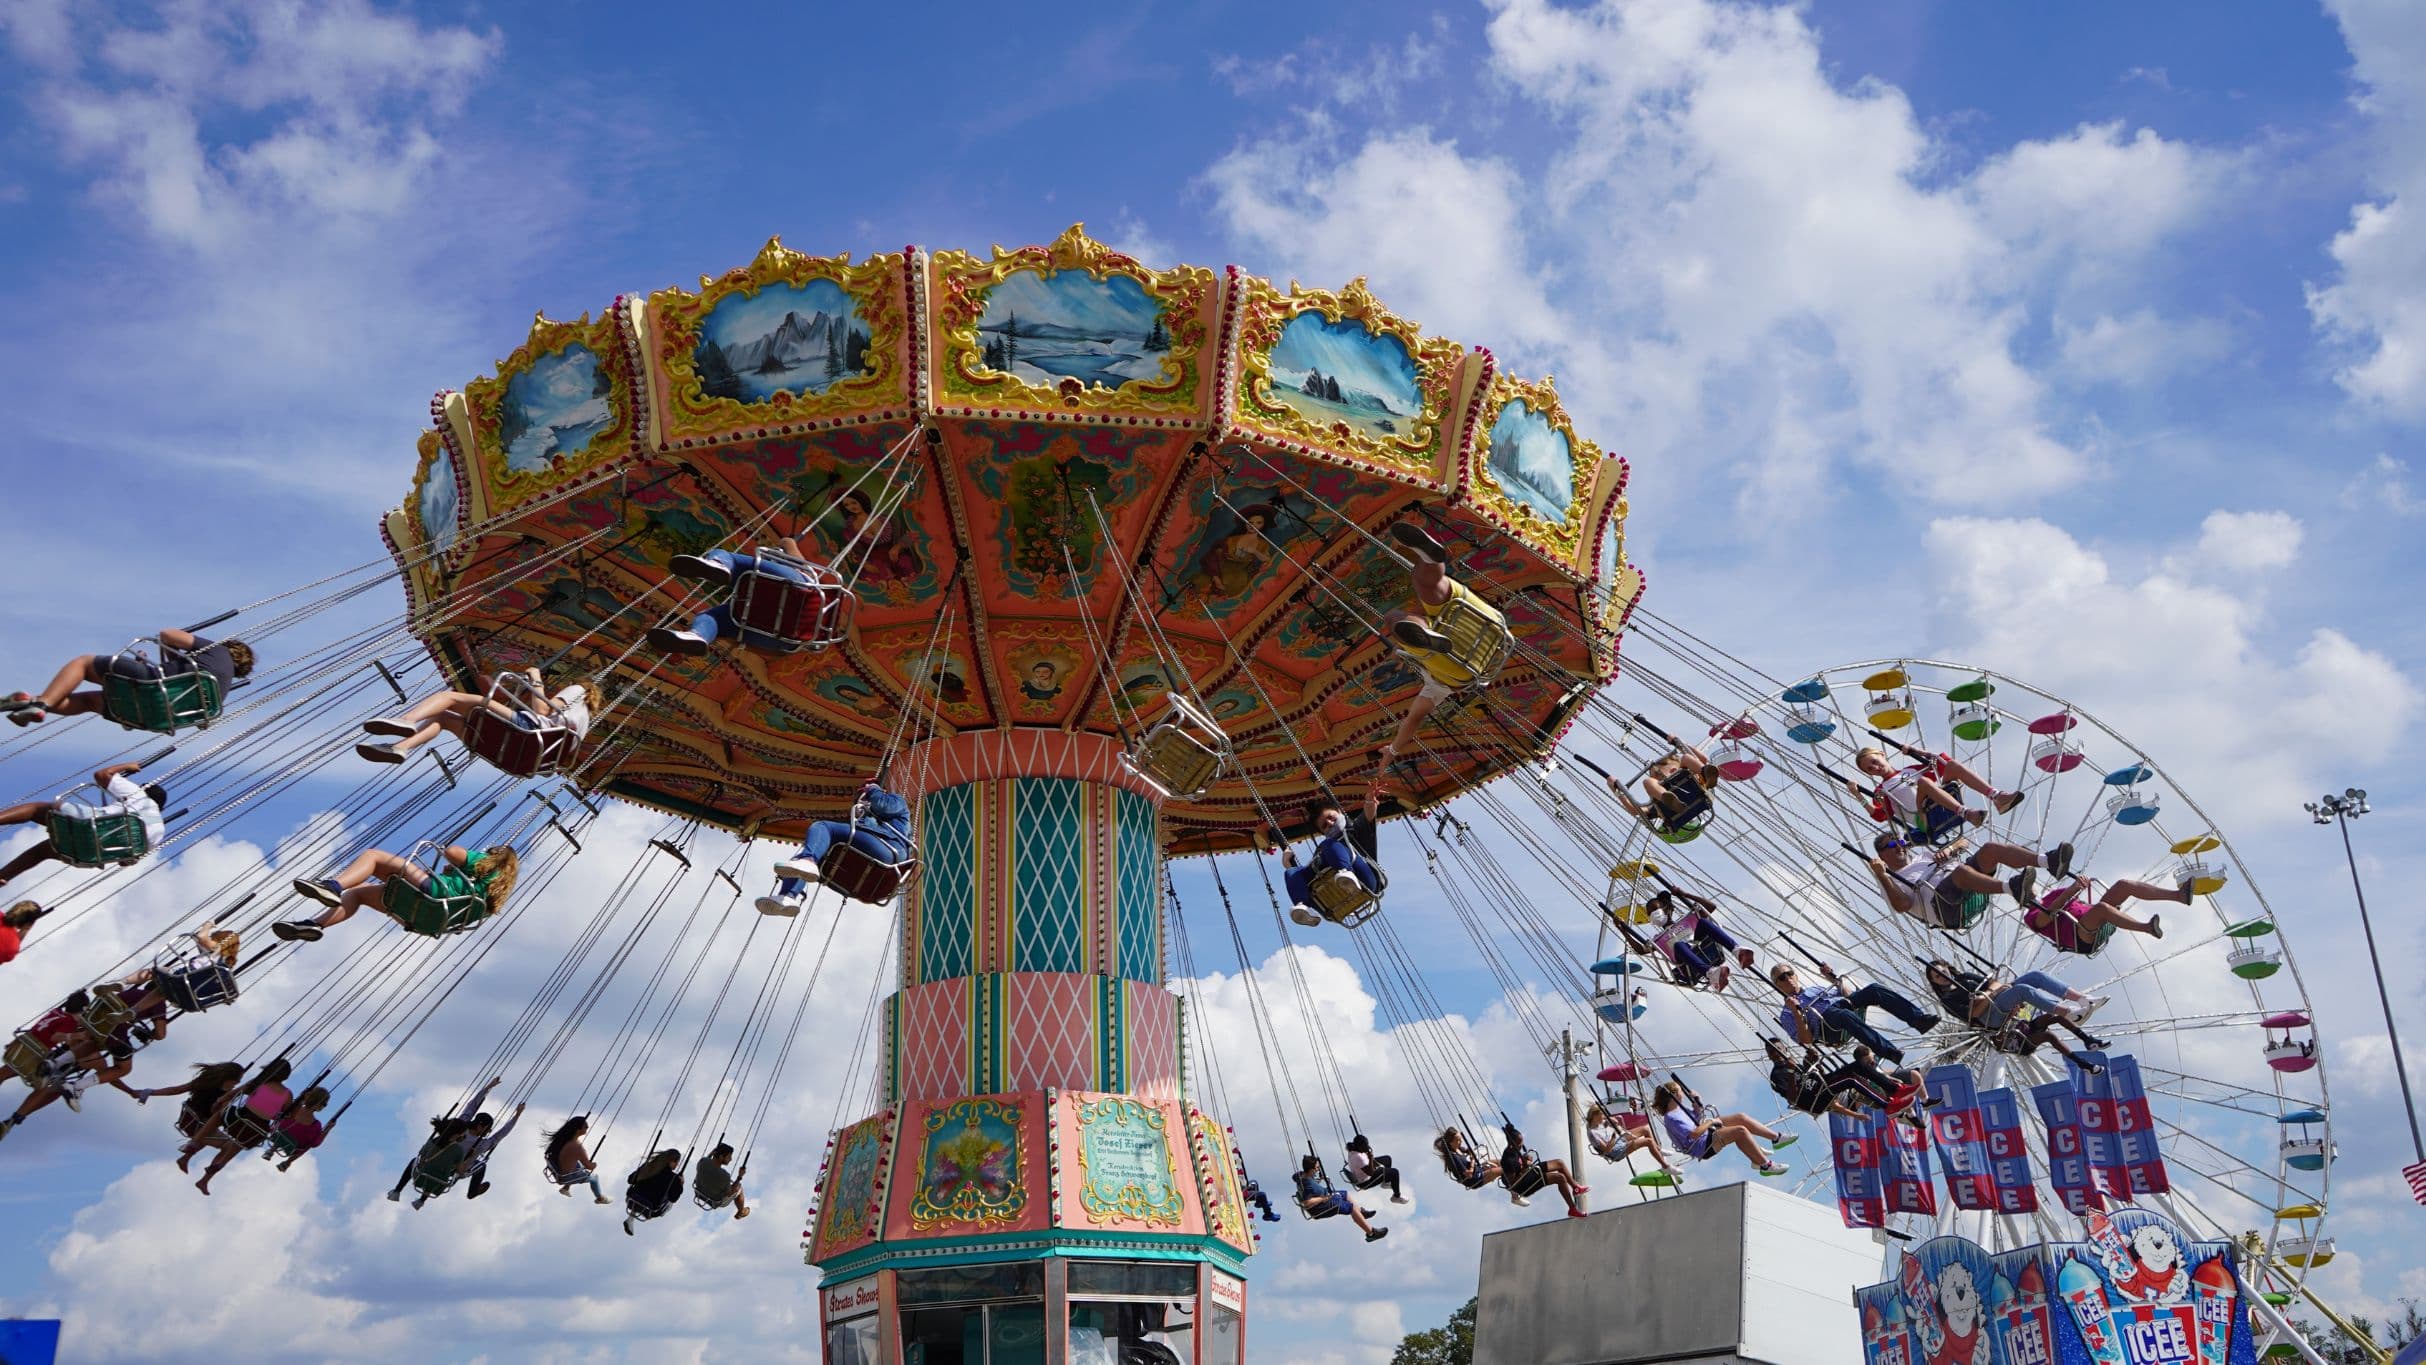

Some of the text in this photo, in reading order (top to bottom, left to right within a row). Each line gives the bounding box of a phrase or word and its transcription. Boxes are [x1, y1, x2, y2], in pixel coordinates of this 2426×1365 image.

[1096, 1136, 1122, 1150] Josef
[1941, 1083, 1978, 1205] ICEE
[1989, 1104, 2021, 1210] ICEE
[2053, 1099, 2086, 1213] ICEE
[2112, 1076, 2150, 1191] ICEE
[1899, 1121, 1919, 1208] CEE
[2101, 1233, 2119, 1251] ICEE
[1913, 1281, 1931, 1310] ICEE
[2074, 1296, 2108, 1328] ICEE
[2198, 1297, 2230, 1325] ICEE
[2005, 1319, 2049, 1365] ICEE
[2122, 1317, 2190, 1365] ICEE
